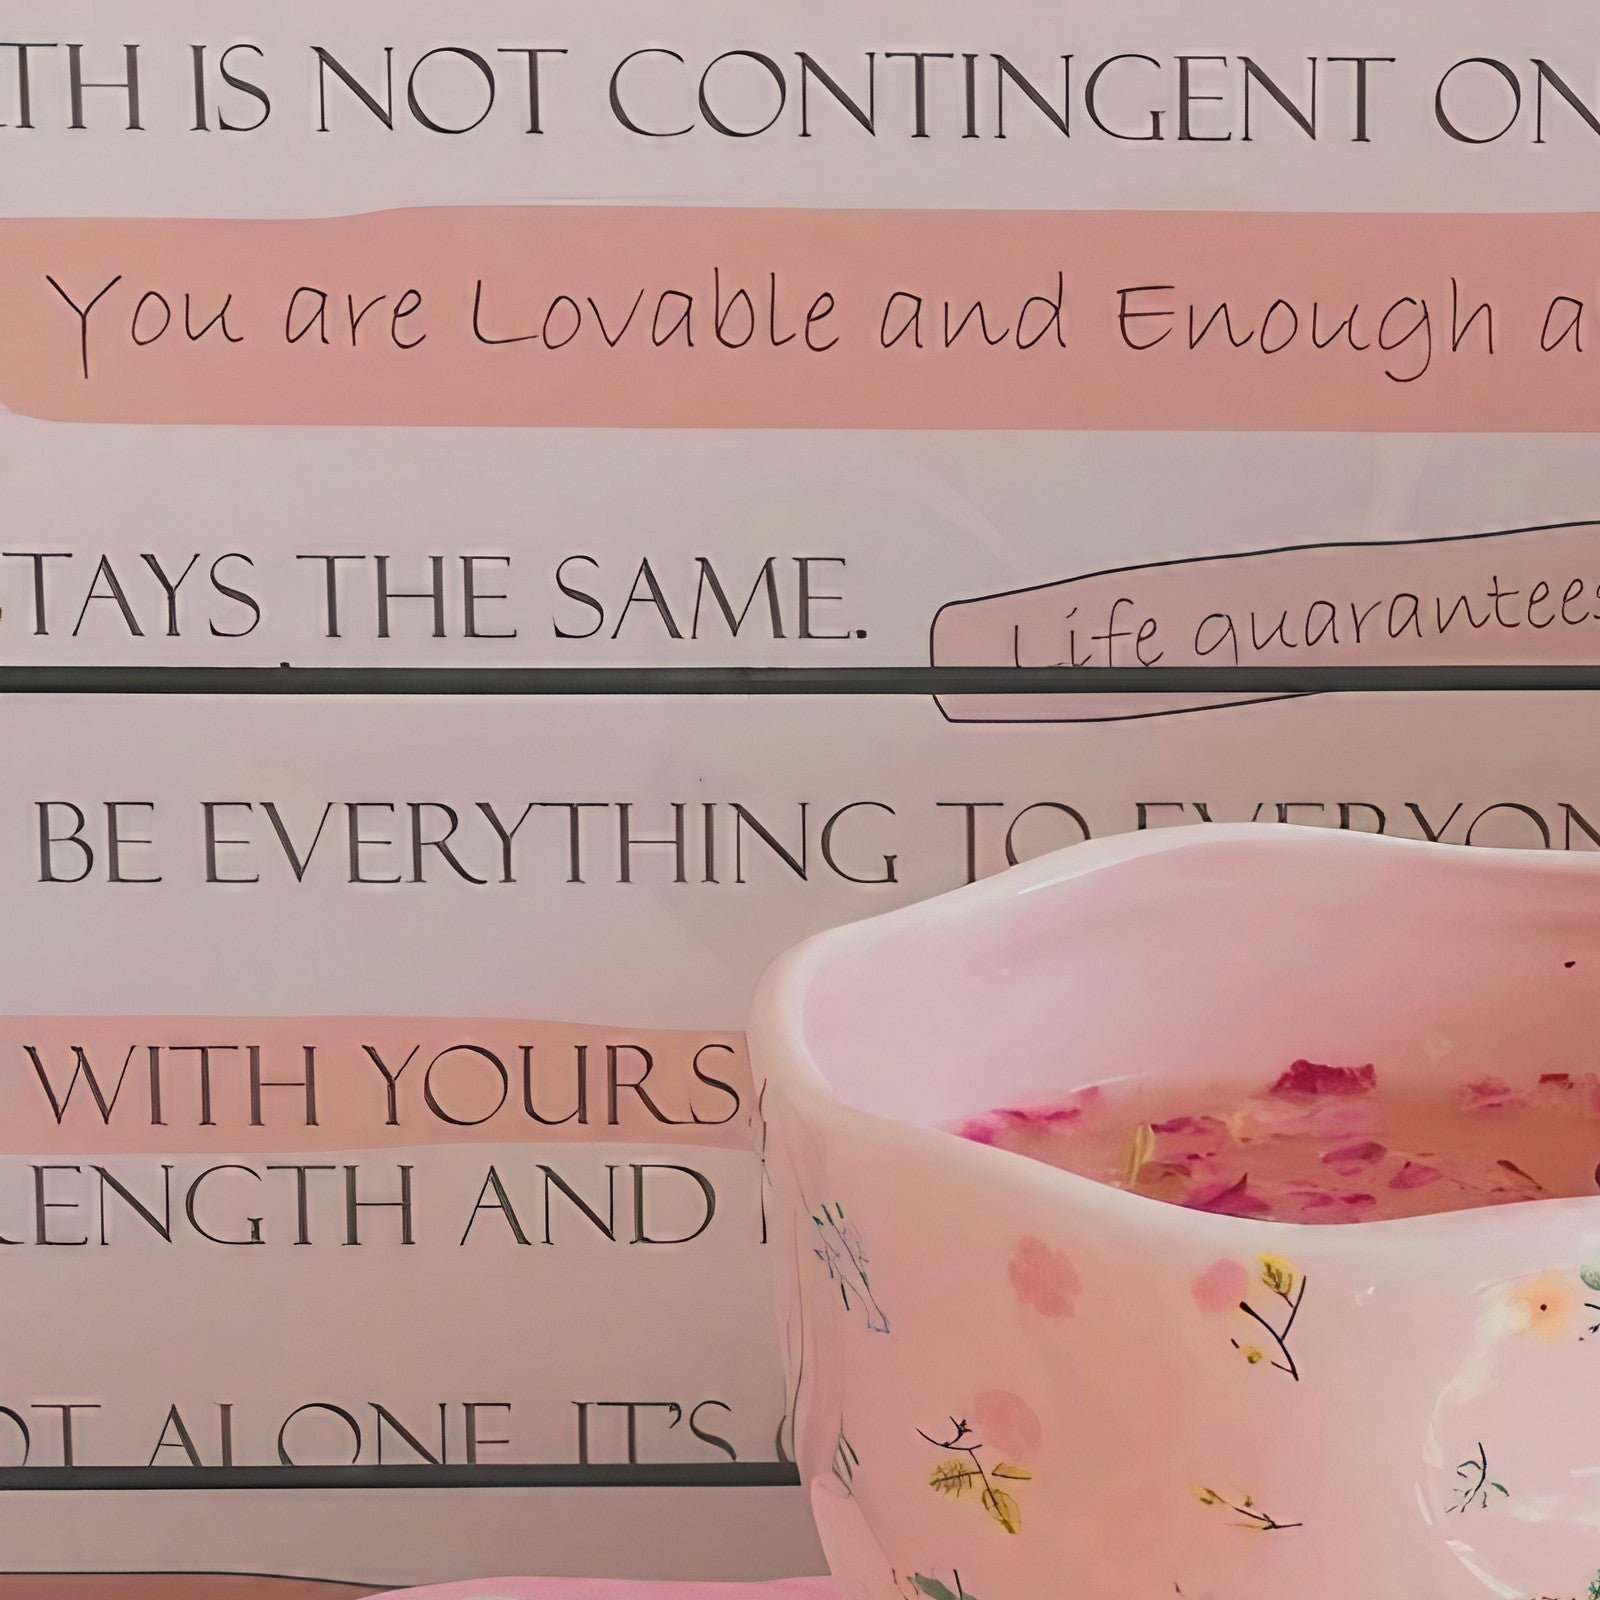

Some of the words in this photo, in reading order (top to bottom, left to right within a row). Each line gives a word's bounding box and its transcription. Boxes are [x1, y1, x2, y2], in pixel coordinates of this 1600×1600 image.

[0, 43, 146, 131] TH
[189, 44, 270, 132] IS
[310, 46, 568, 135] NOT
[609, 49, 1396, 142] CONTINGENT
[46, 275, 244, 379] You
[286, 287, 426, 349] are
[473, 267, 839, 352] Lovable
[881, 271, 1066, 349] and
[1116, 277, 1494, 383] Enough
[0, 552, 260, 637] TAYS
[296, 555, 517, 638] THE
[553, 555, 867, 639] SAME.
[34, 801, 162, 883] BE
[200, 802, 898, 885] EVERYTHING
[936, 802, 1091, 885] TO
[23, 1045, 319, 1126] WITH
[362, 1044, 740, 1126] YOURS
[0, 1165, 415, 1245] ENGTH
[460, 1164, 716, 1245] AND
